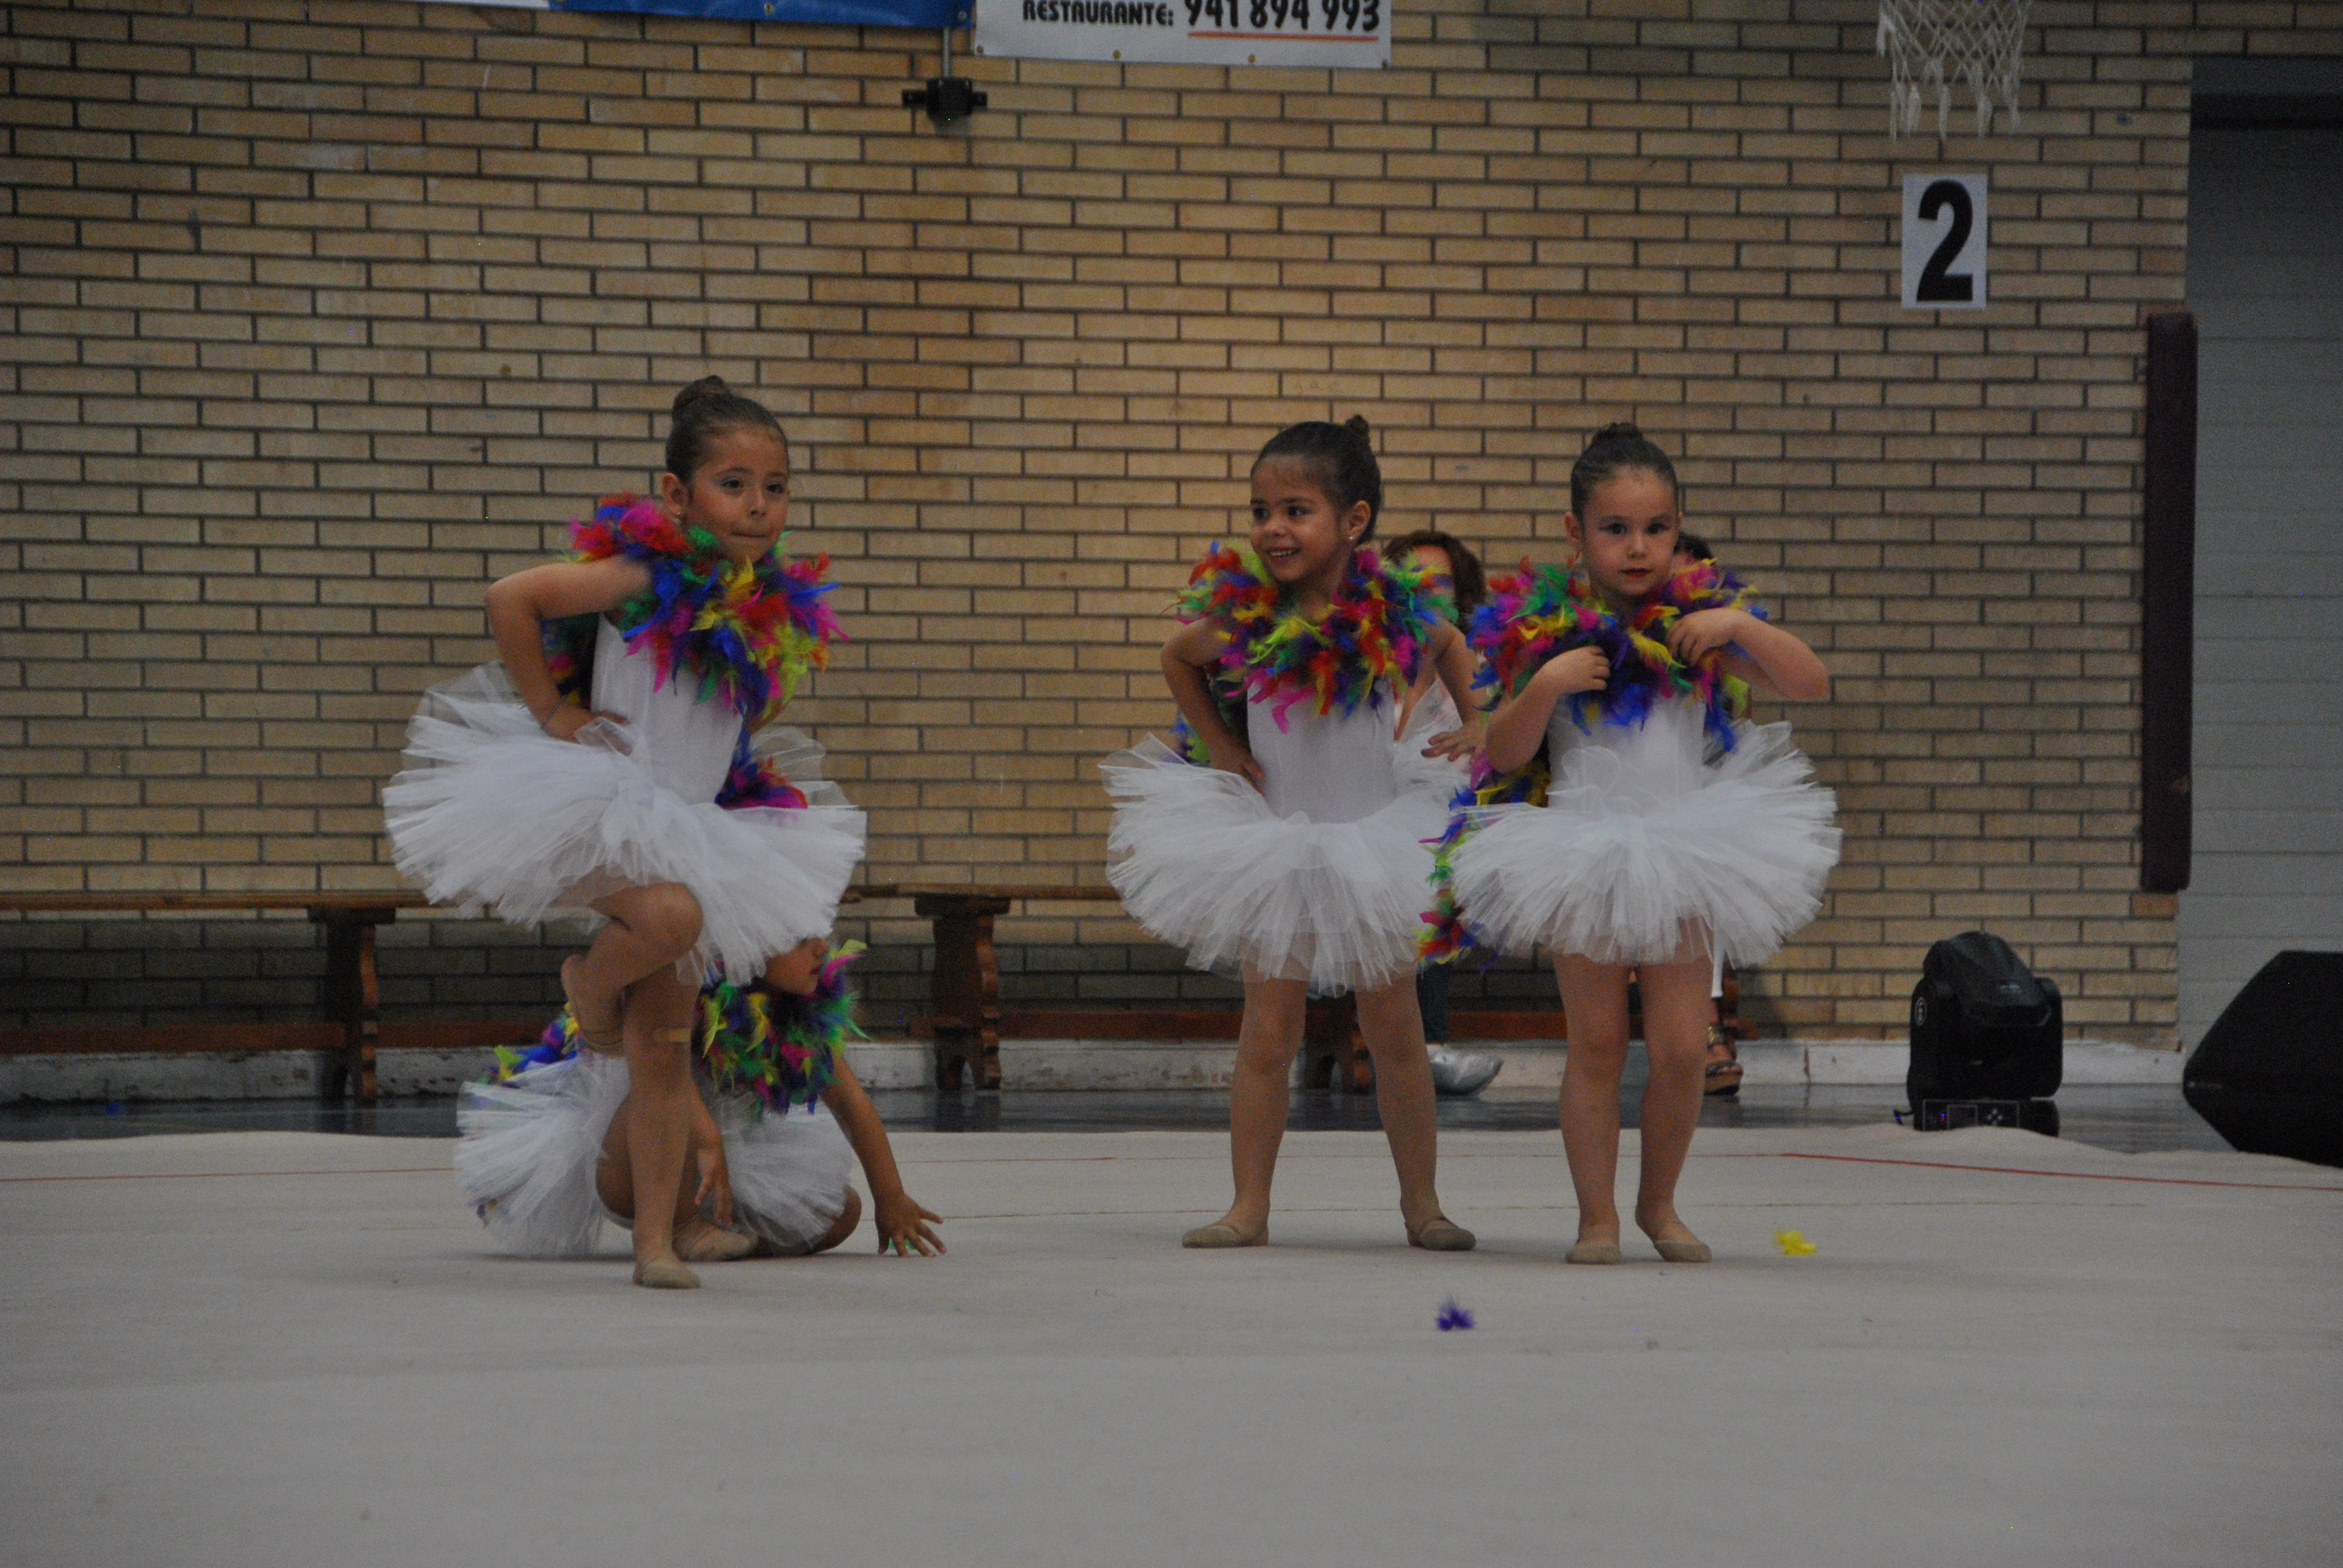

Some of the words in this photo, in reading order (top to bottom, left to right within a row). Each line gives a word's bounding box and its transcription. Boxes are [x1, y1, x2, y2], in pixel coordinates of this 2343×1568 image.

[1023, 0, 1173, 26] RESTAURANTE:
[1184, 0, 1239, 27] 941
[1250, 0, 1309, 30] 894
[1322, 0, 1380, 31] 993
[1916, 179, 1973, 302] 2
